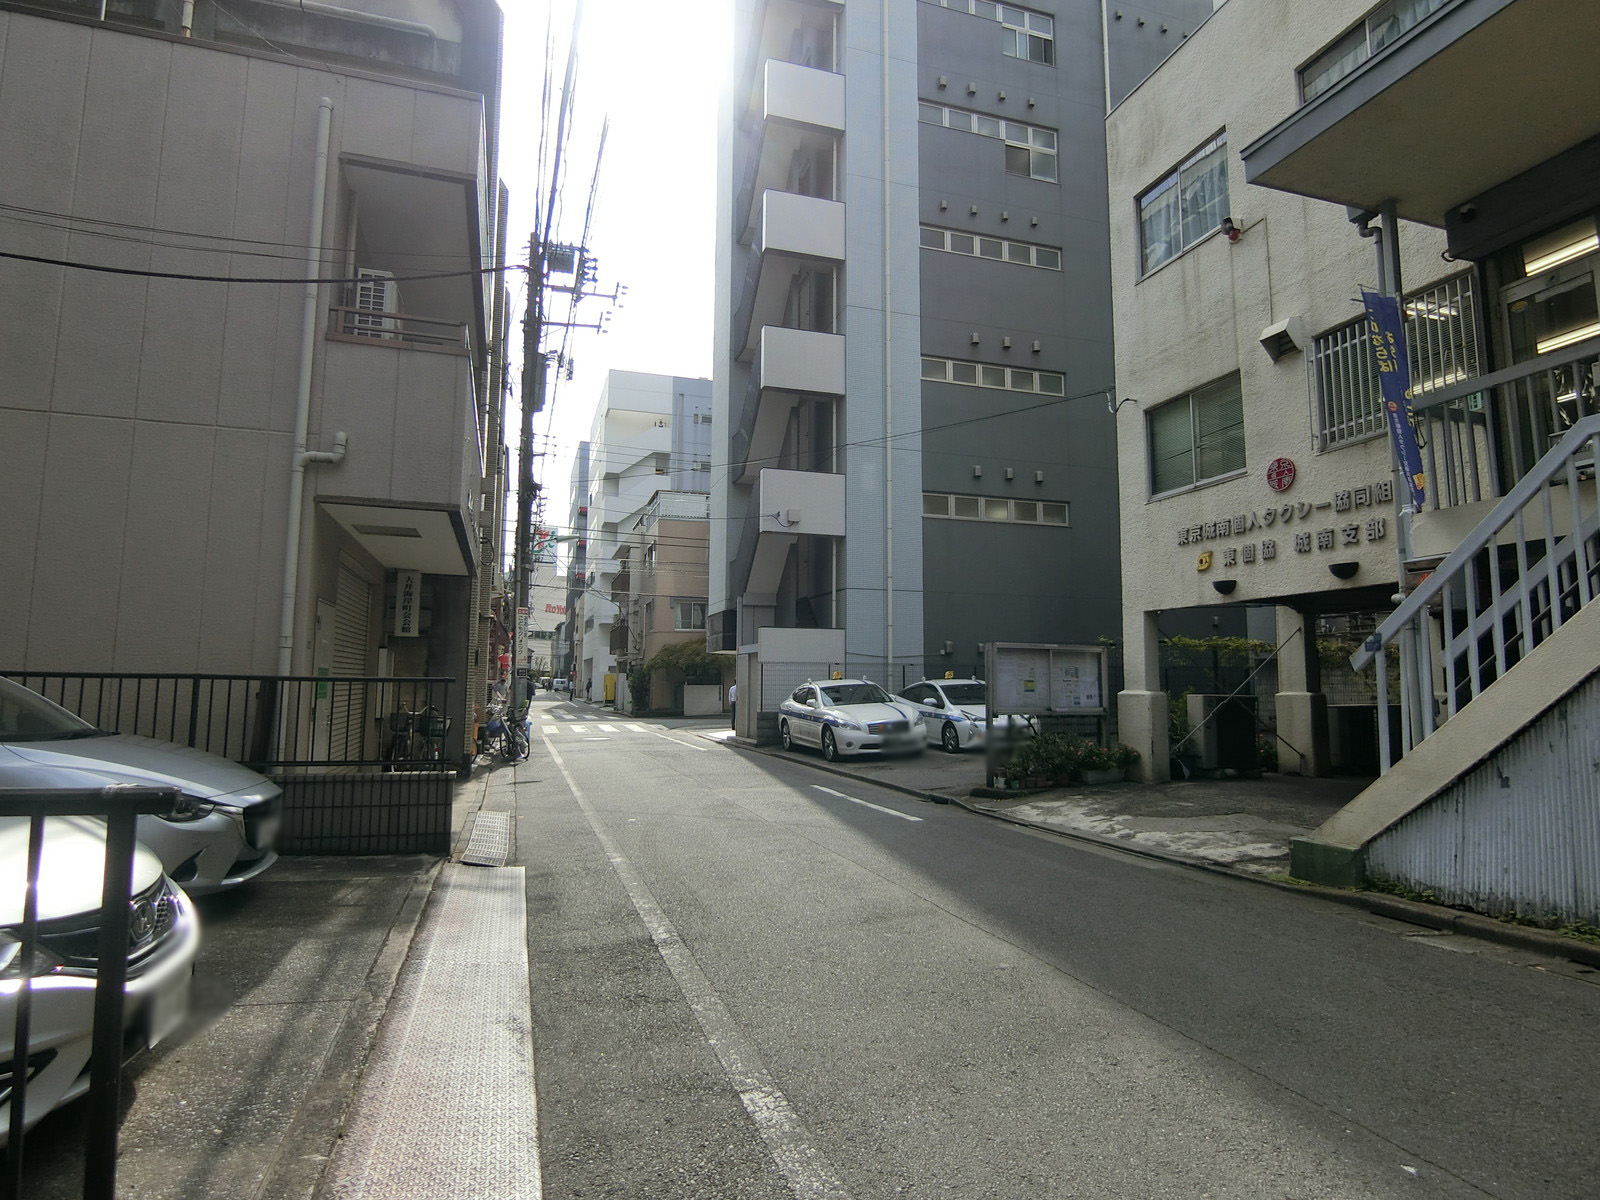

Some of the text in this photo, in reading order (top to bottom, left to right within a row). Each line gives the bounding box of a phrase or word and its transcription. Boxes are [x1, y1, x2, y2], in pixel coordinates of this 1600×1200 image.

[1223, 517, 1386, 566] 東個協 城南支部
